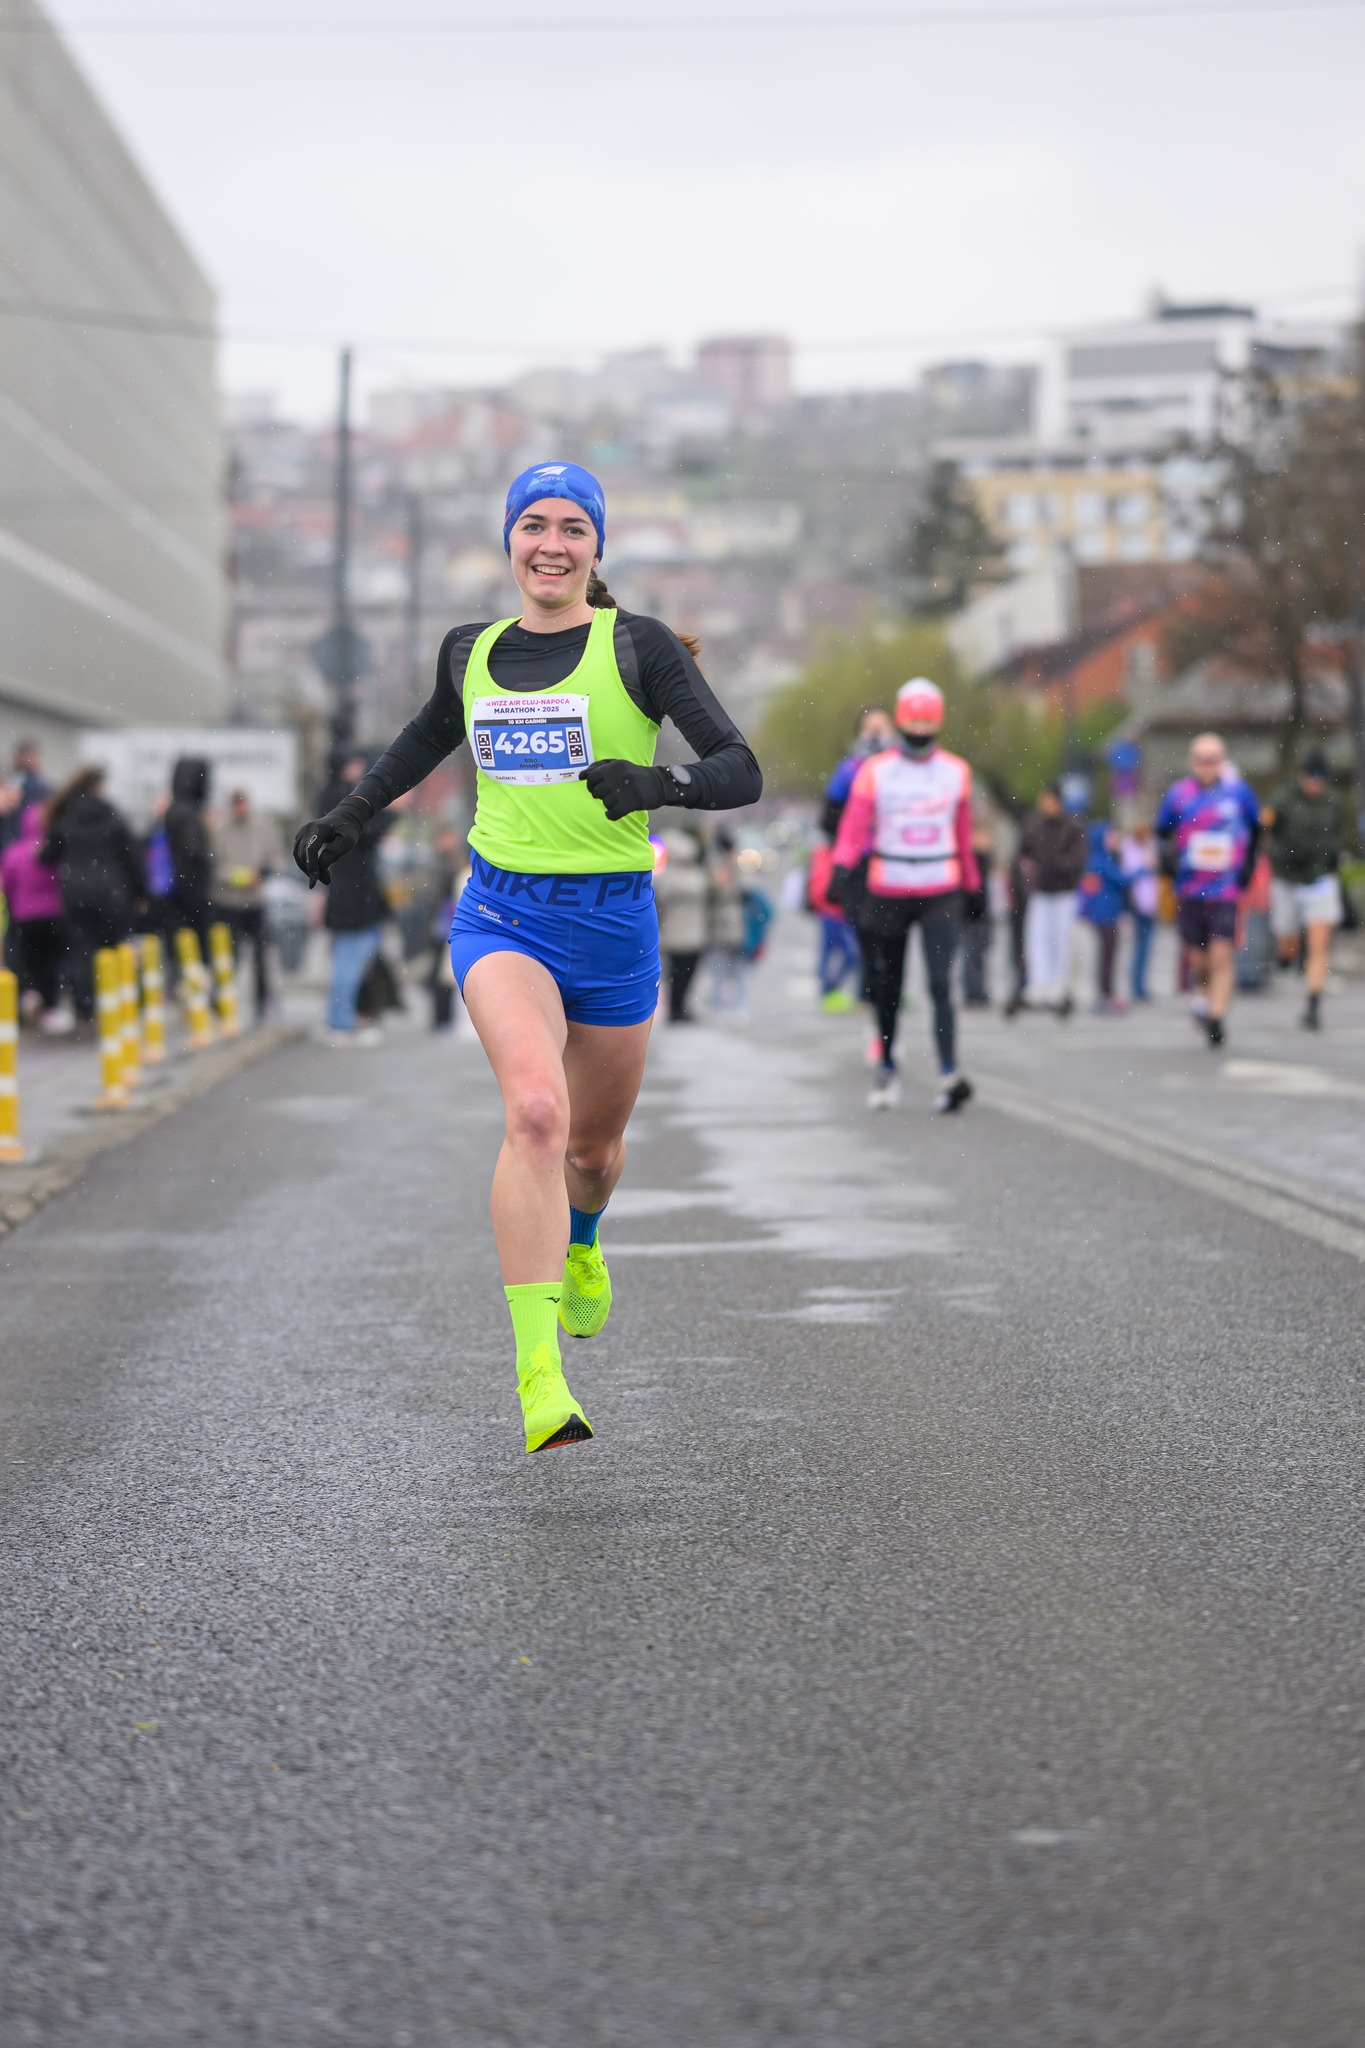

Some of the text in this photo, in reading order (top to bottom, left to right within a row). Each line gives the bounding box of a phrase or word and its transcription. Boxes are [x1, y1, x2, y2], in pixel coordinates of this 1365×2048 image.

[522, 698, 570, 706] CLUJ-NAPOCA
[494, 731, 566, 755] 4265
[472, 855, 588, 907] NIKE
[483, 904, 501, 919] happy
